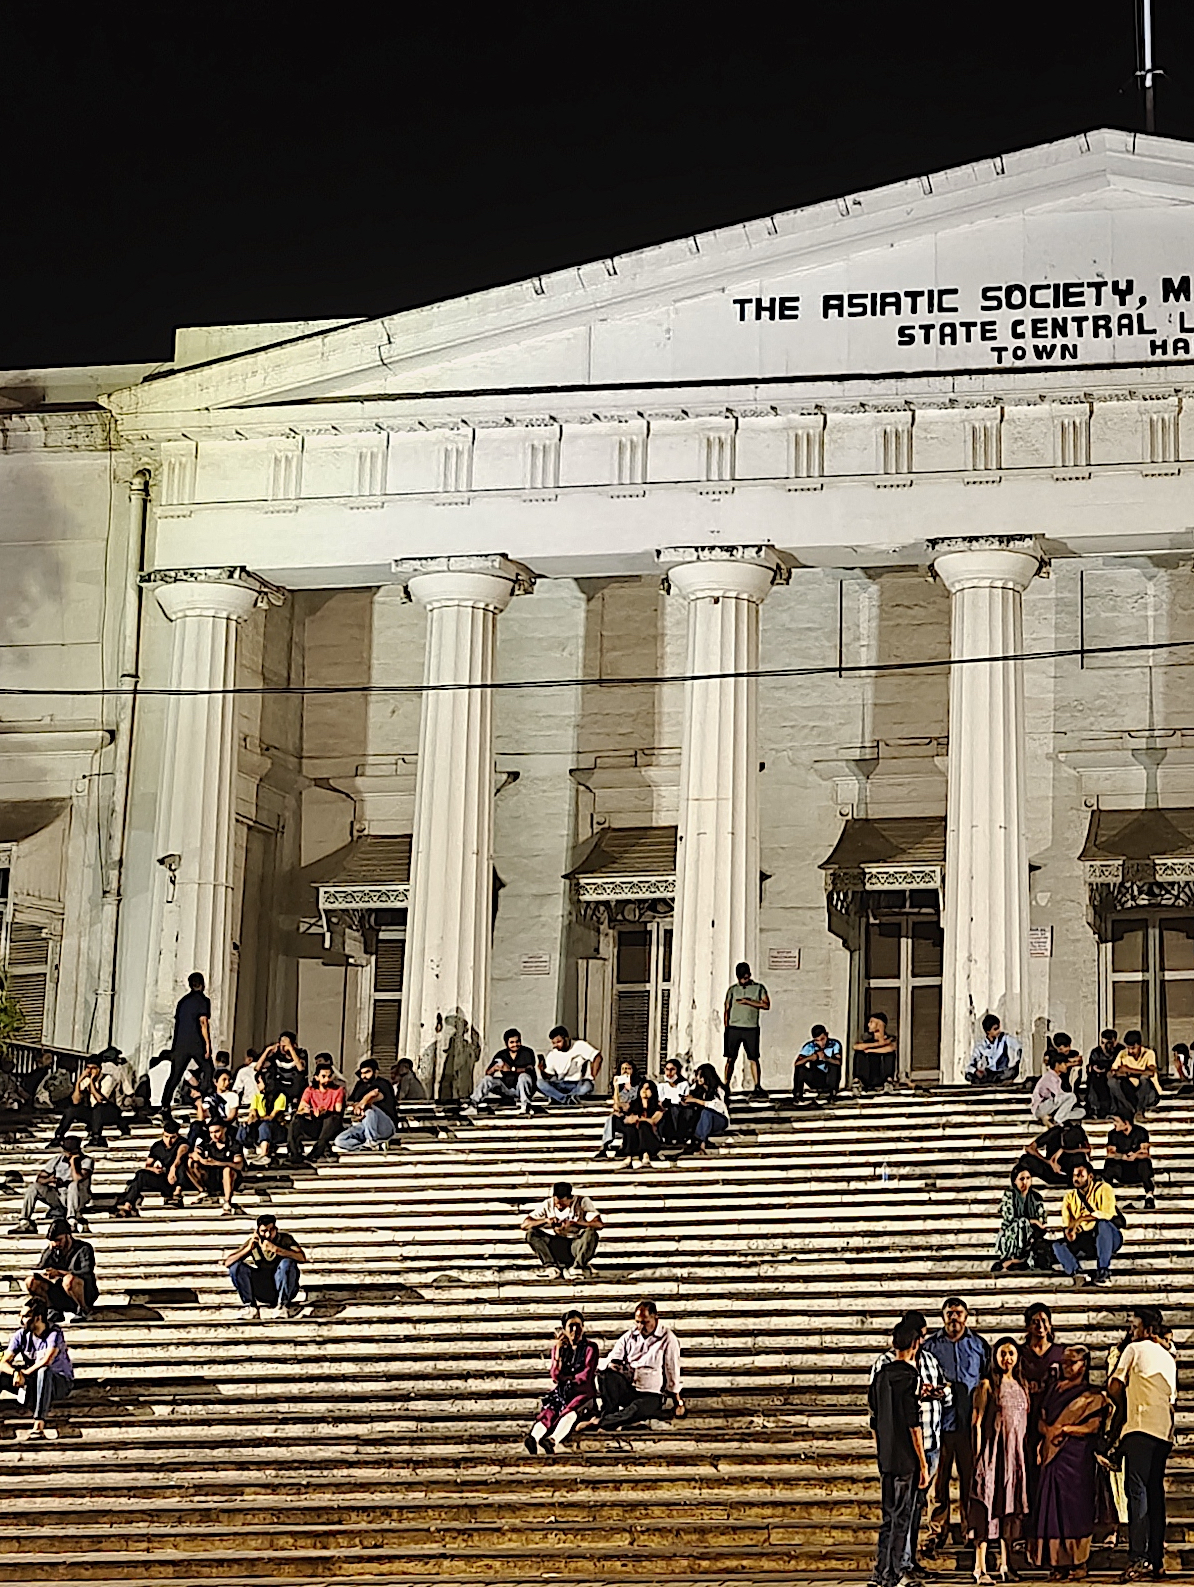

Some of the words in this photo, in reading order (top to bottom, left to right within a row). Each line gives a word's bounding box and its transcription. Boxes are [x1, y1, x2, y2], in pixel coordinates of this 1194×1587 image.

[732, 294, 800, 322] THE
[822, 287, 959, 320] ASIATIC
[980, 279, 1147, 312] SOCIETY,
[897, 320, 998, 346] STATE
[1011, 312, 1158, 340] CENTRAL
[990, 343, 1078, 365] TOWN
